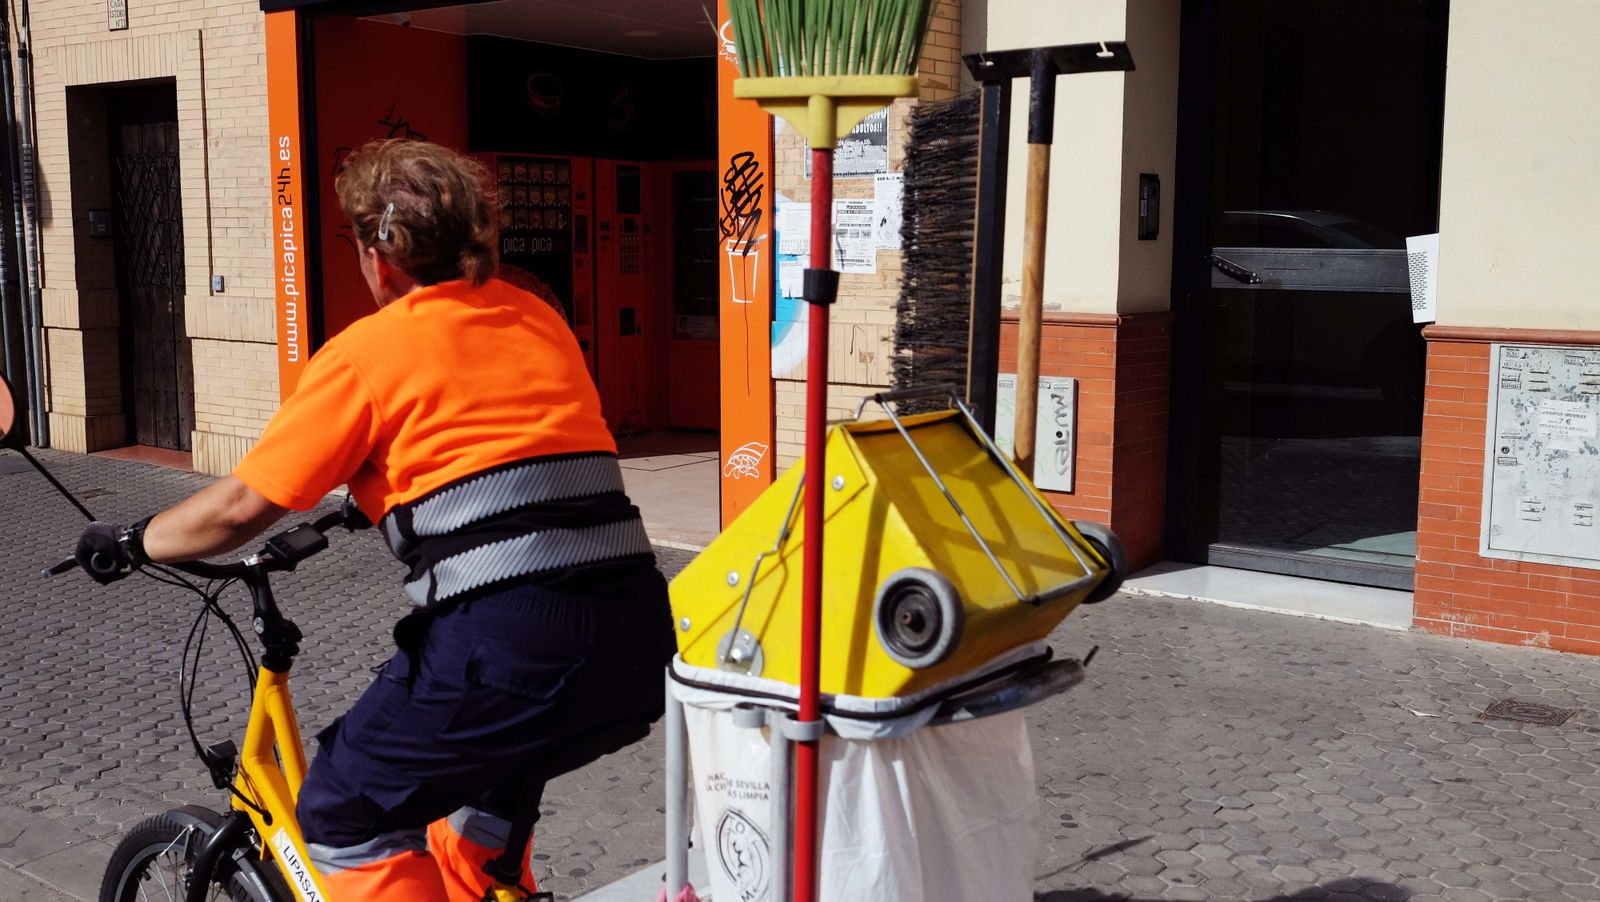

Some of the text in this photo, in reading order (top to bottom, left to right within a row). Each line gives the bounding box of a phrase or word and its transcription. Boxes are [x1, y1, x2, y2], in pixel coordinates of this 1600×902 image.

[277, 136, 300, 363] www.picapica24h.es
[503, 237, 553, 255] pica pica
[735, 779, 770, 790] SEVILLA
[739, 790, 769, 801] LIMPIA
[283, 845, 320, 902] LIPASA
